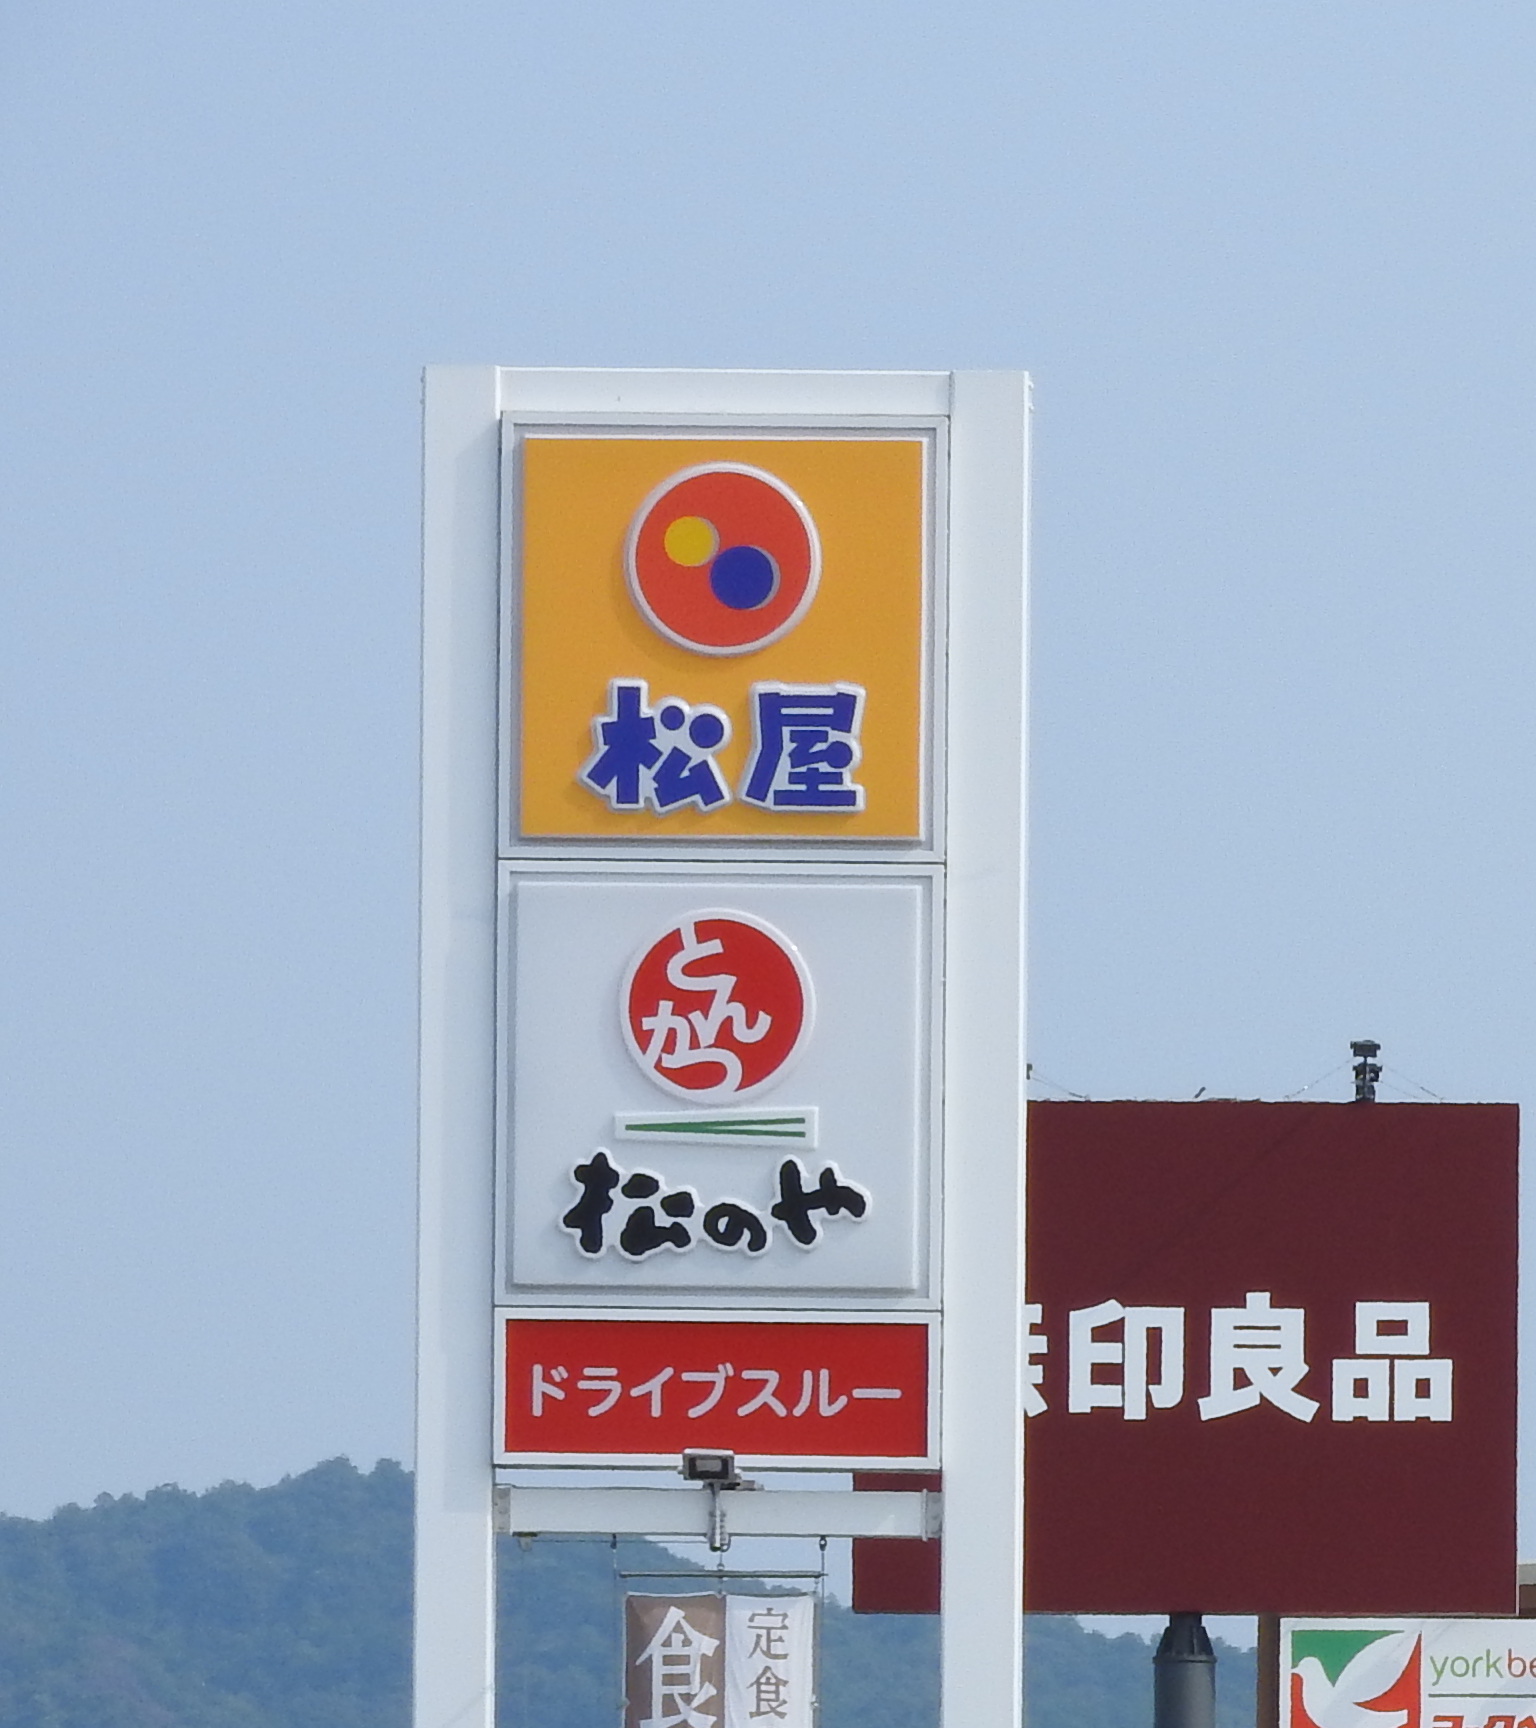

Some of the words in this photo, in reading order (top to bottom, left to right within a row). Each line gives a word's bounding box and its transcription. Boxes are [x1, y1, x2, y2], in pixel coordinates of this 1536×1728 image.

[581, 679, 864, 813] 松屋
[560, 1149, 869, 1258] 松のや
[530, 1363, 902, 1418] ドライブスルー
